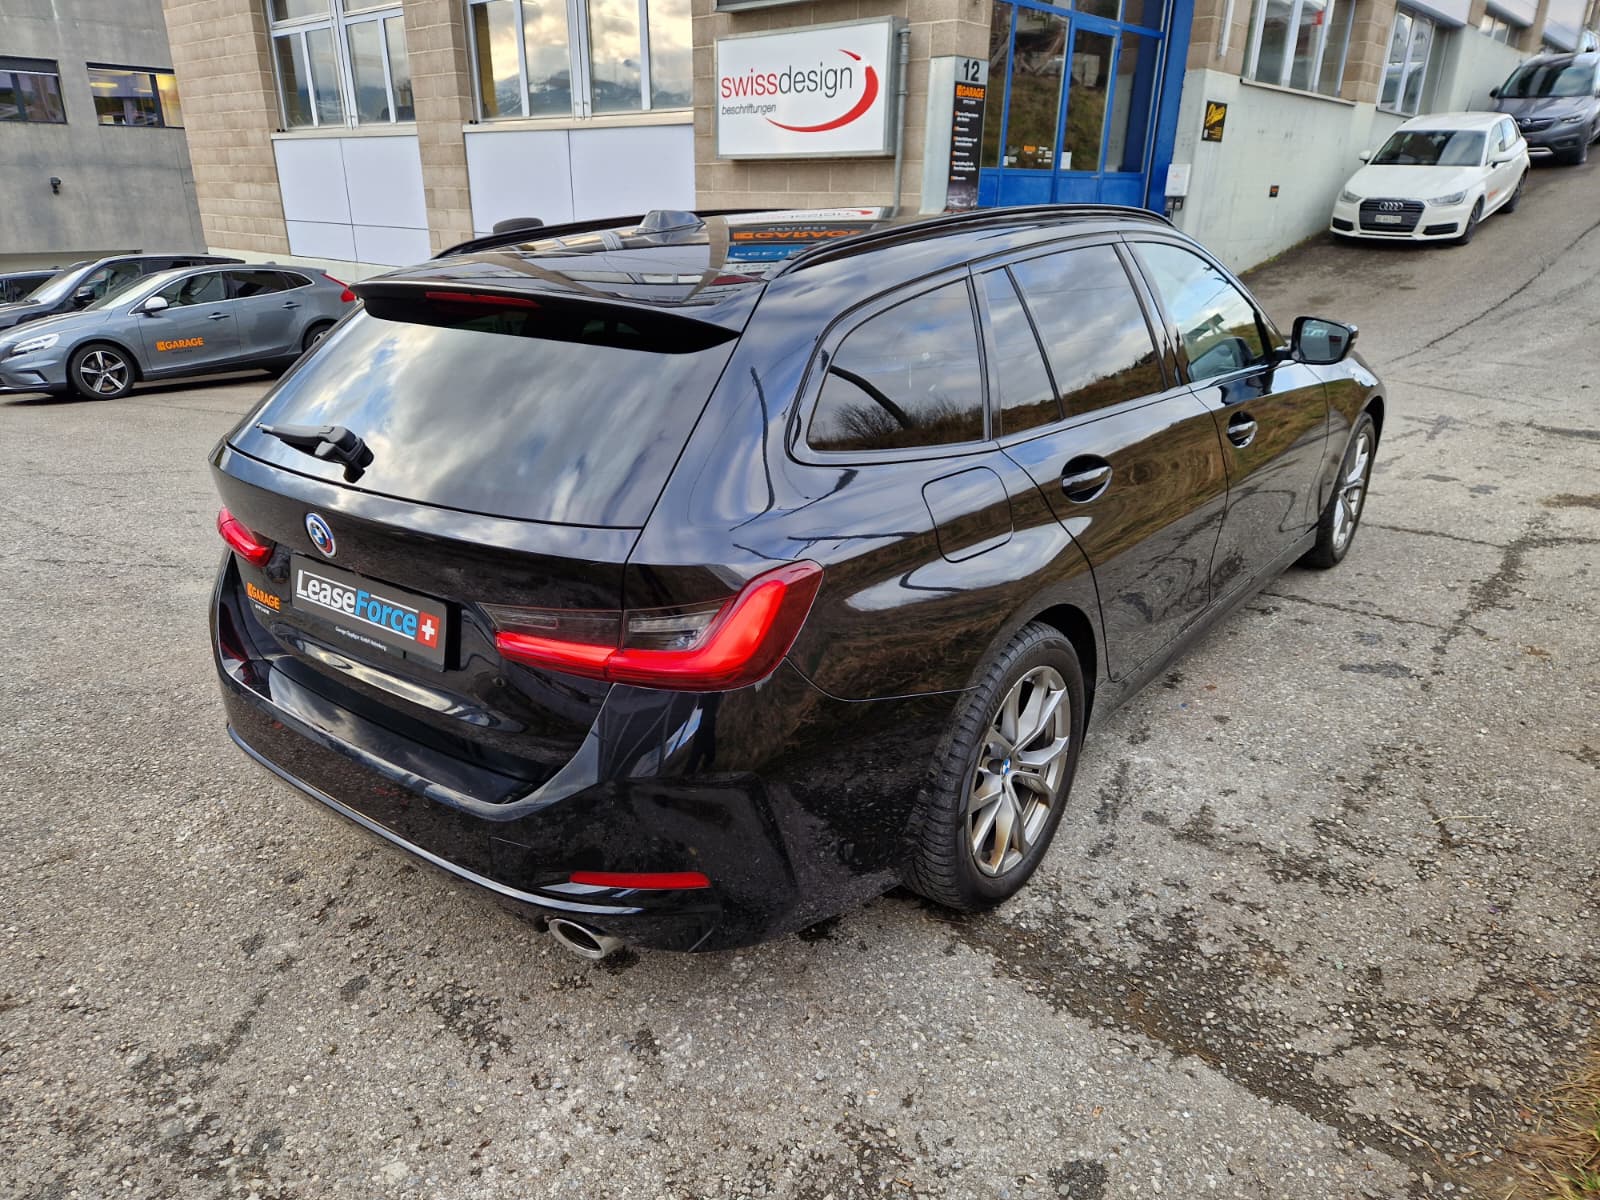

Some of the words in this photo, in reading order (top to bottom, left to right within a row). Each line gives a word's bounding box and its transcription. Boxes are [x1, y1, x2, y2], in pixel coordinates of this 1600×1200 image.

[721, 61, 853, 99] swissdesign
[963, 59, 980, 82] 12
[721, 103, 777, 116] beschriftungen
[164, 336, 205, 350] GARAGE
[251, 586, 281, 610] GARAGE
[296, 569, 418, 637] LeaseForce
